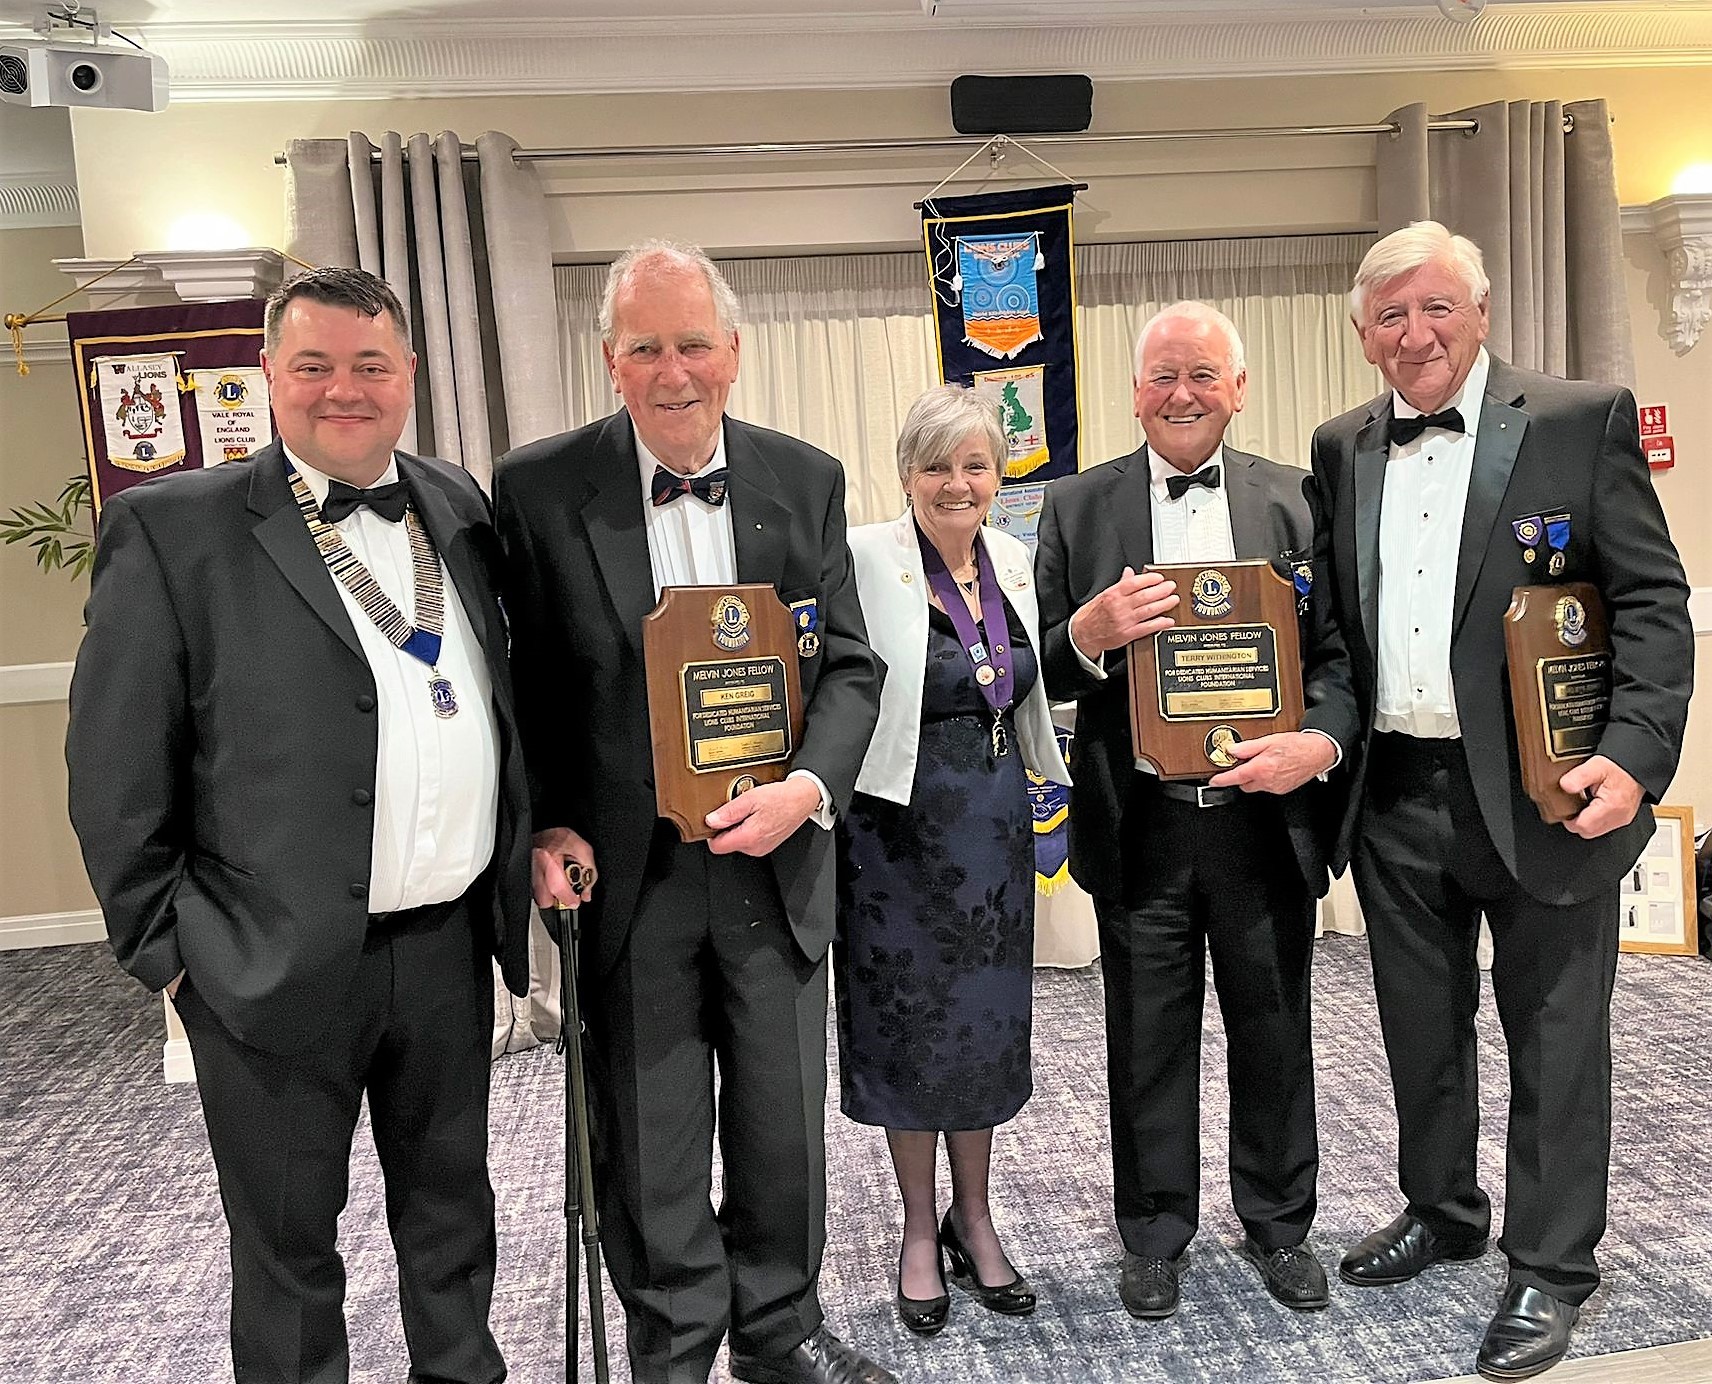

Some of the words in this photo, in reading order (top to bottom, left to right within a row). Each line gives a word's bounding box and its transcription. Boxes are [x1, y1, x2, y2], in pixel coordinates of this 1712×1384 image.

[112, 364, 162, 374] WALLASEY
[139, 371, 167, 379] LIONS
[1167, 633, 1197, 644] MELVIN
[1200, 632, 1228, 642] JONES
[1230, 631, 1262, 641] FELLOW
[1181, 654, 1206, 662] TERRY
[1206, 652, 1252, 661] WITHINGTON
[693, 669, 720, 681] MELVIN
[721, 667, 746, 678] JONES
[748, 665, 774, 676] FELLOW
[1176, 667, 1205, 676] DEDICATED
[1200, 680, 1236, 688] FOUNDATION
[720, 692, 734, 700] KEN
[735, 690, 755, 699] GREIG
